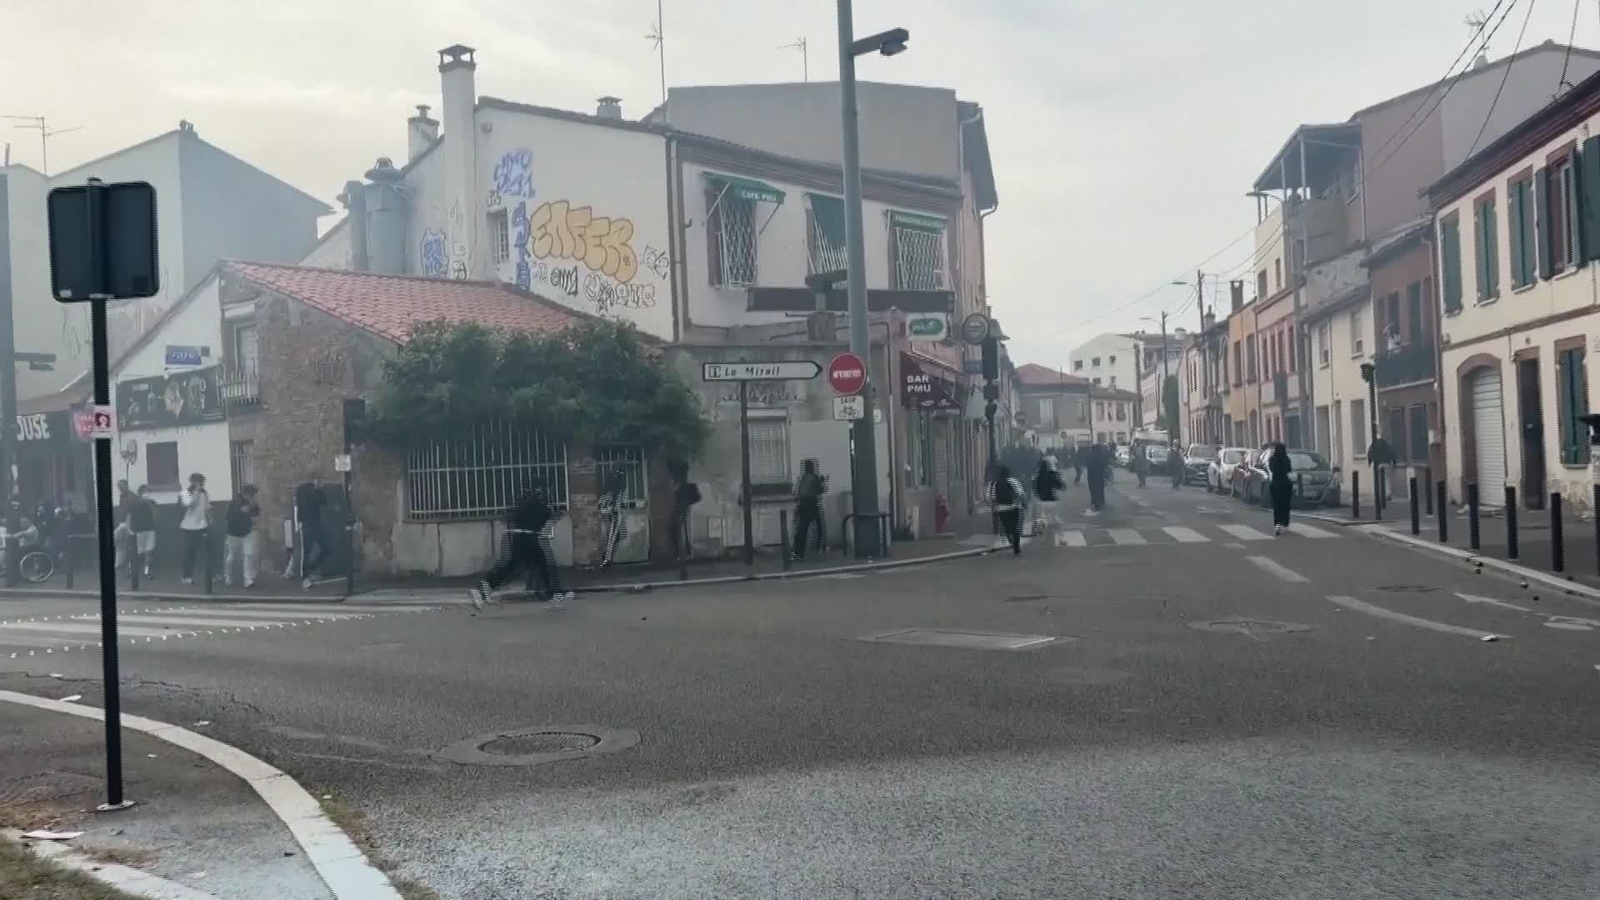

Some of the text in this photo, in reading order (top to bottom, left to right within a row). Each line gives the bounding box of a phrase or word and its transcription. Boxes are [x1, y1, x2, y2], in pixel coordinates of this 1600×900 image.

[725, 365, 780, 377] Le Mirail
[906, 375, 930, 384] BAR
[906, 385, 931, 393] PMU
